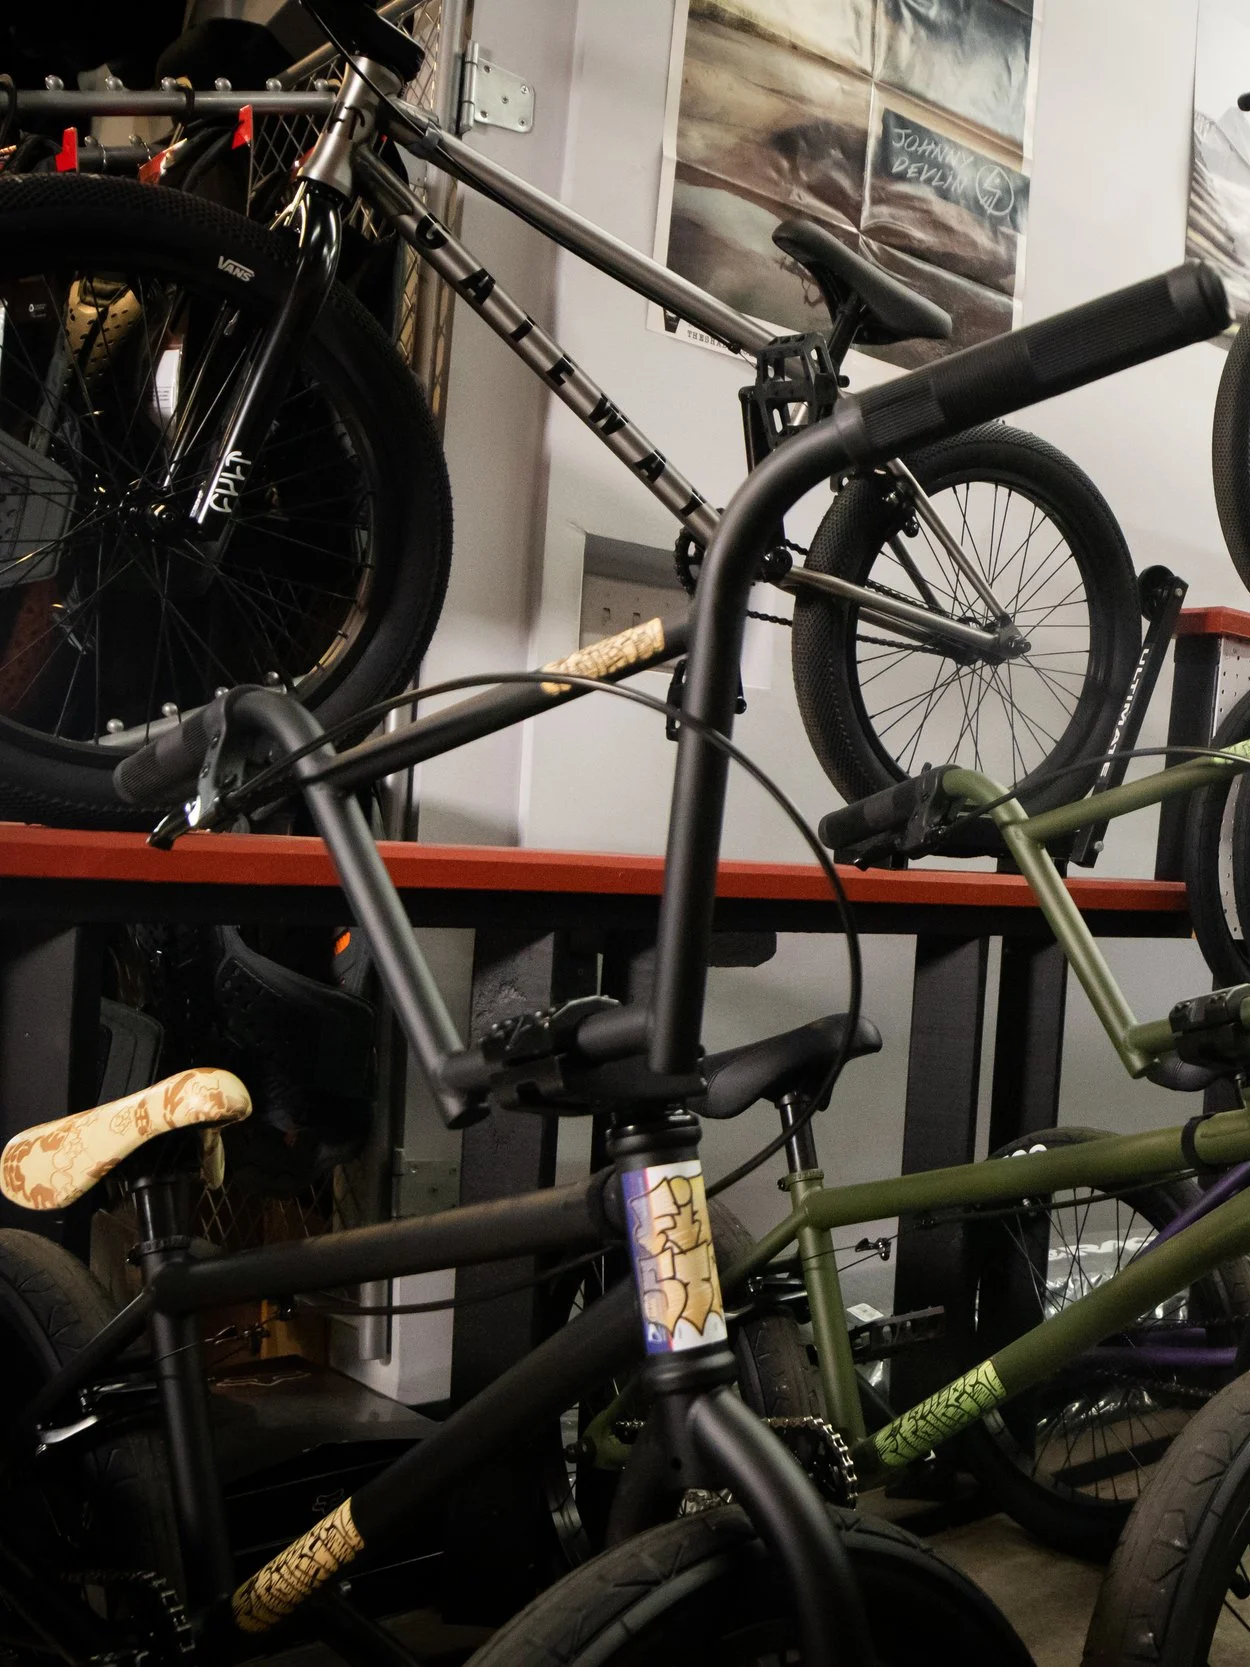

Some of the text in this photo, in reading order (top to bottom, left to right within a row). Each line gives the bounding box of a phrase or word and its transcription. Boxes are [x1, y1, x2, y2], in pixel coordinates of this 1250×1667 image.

[891, 127, 975, 170] JOHNNY
[890, 156, 968, 194] DEVLIN
[217, 255, 256, 283] VANS
[208, 450, 252, 514] CULT
[1100, 647, 1150, 778] ULTIMATE
